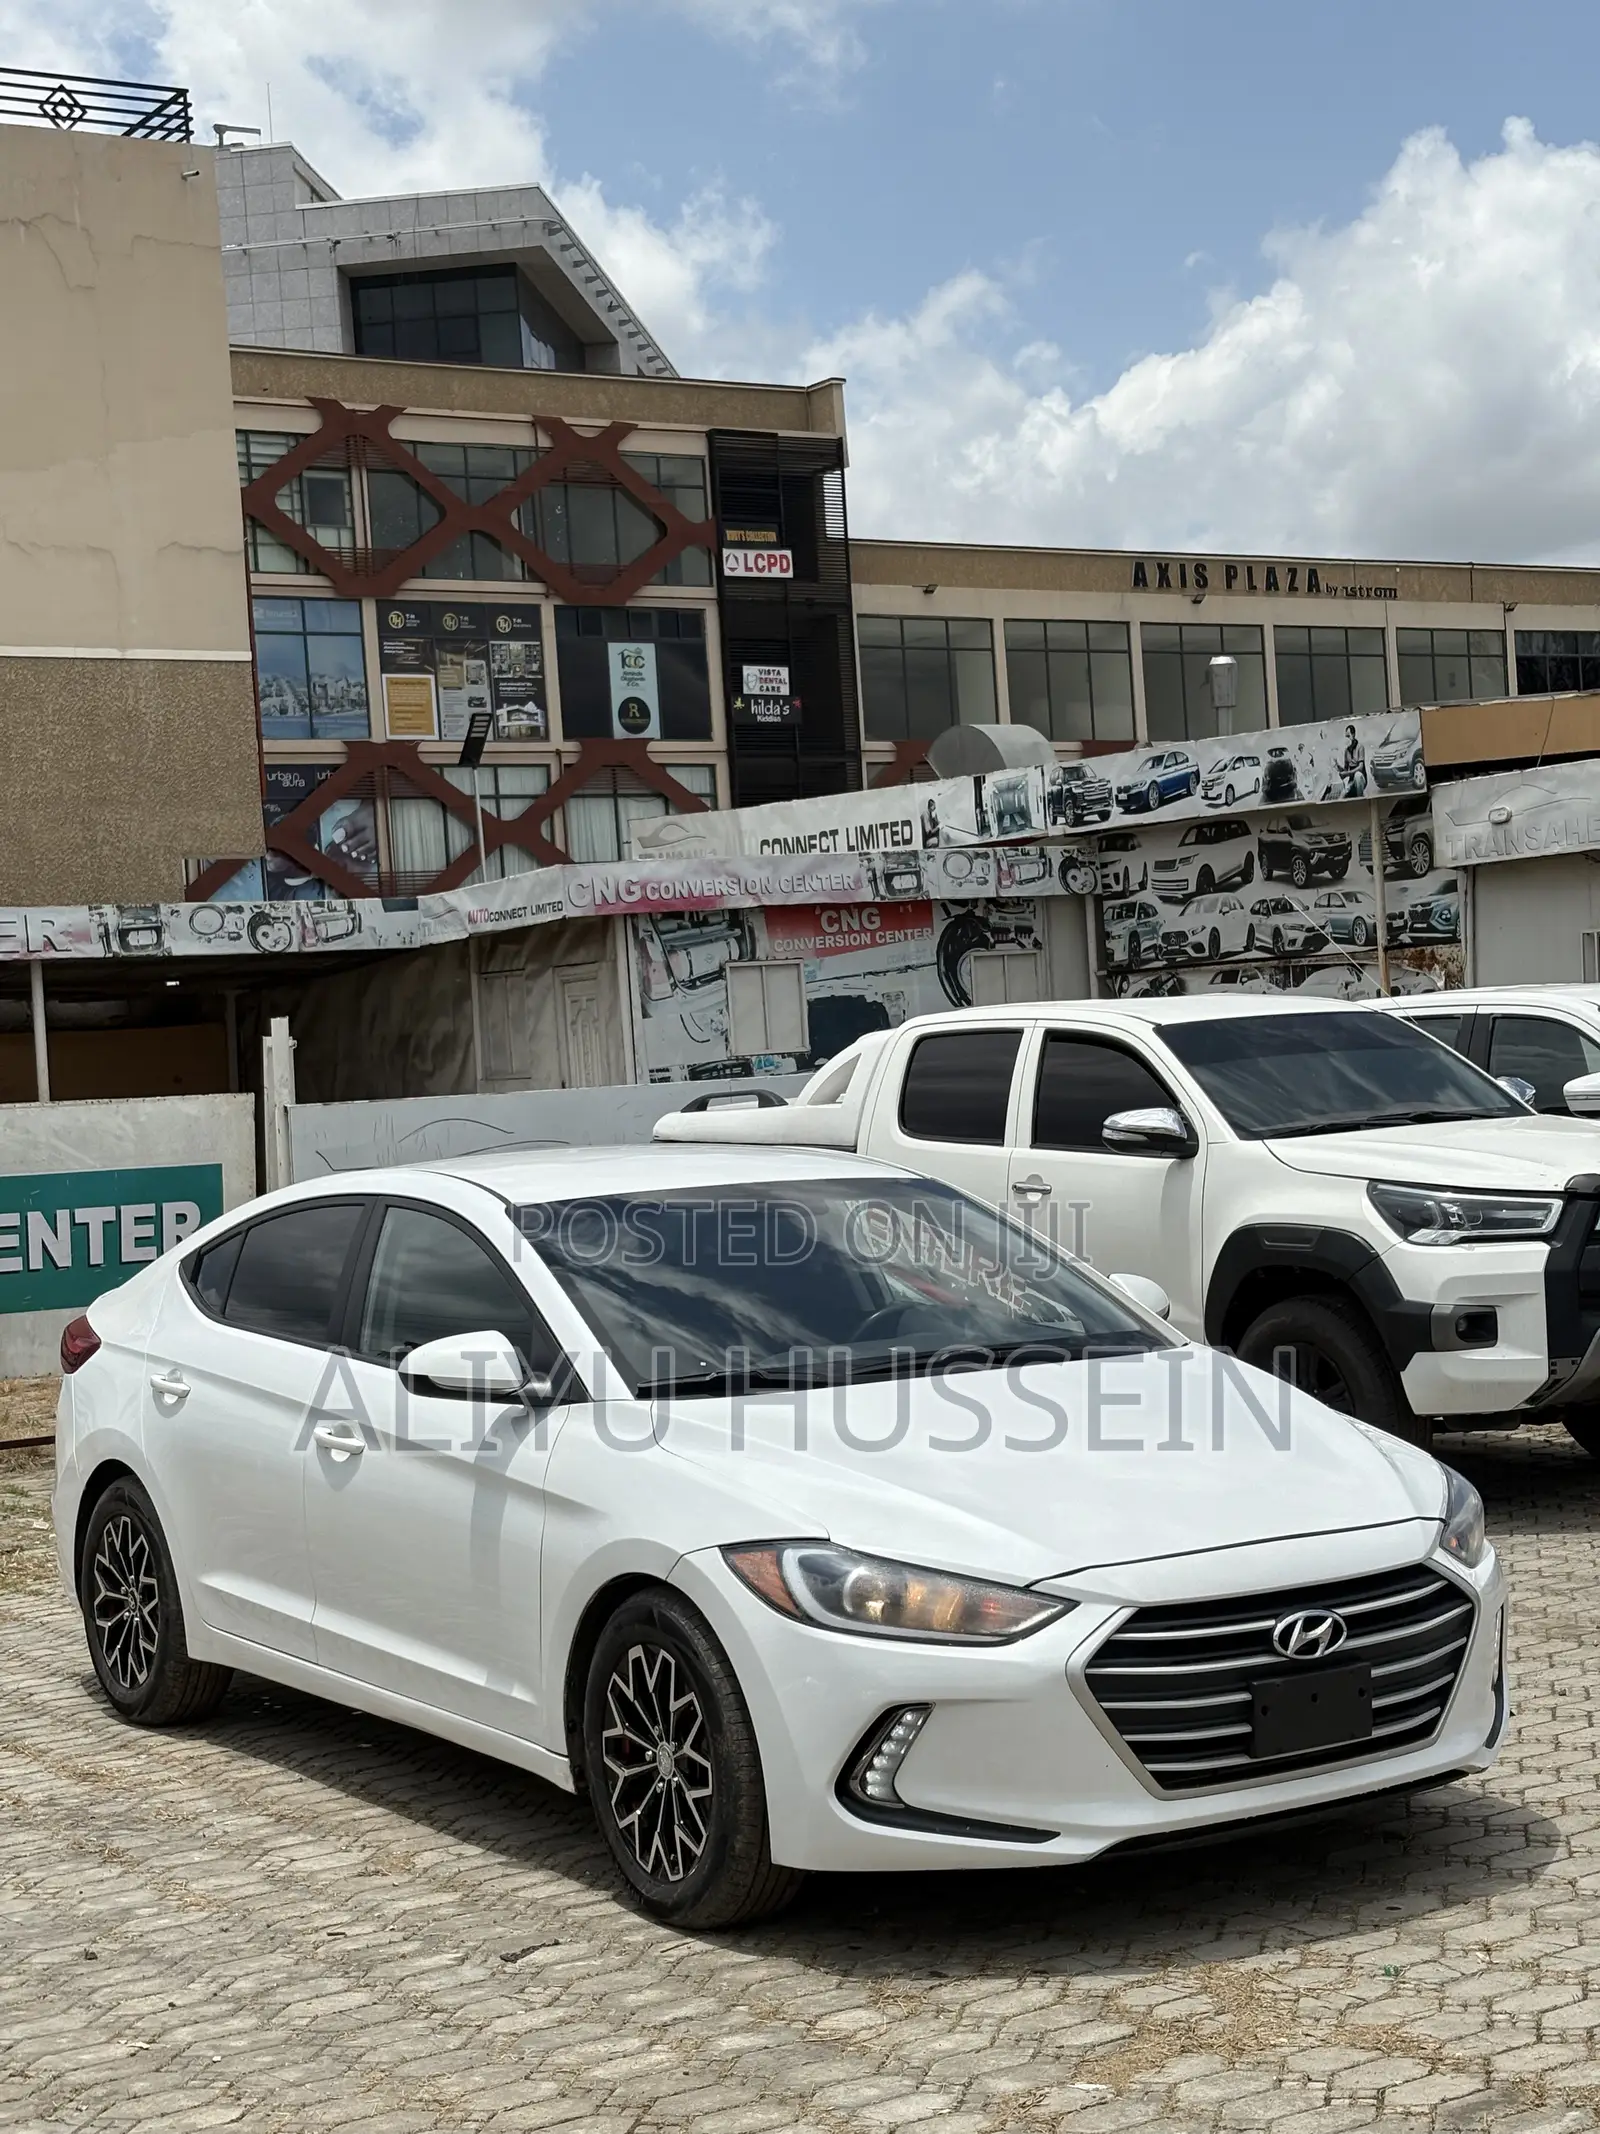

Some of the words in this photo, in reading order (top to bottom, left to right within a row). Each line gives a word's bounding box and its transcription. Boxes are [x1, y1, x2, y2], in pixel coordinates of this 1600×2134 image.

[743, 553, 790, 573] LCPD
[1132, 562, 1208, 589] AXIS
[1224, 564, 1321, 593] PLAZA
[1325, 582, 1338, 597] by
[758, 668, 781, 676] VISTA
[759, 677, 787, 685] DENTAL
[759, 685, 781, 693] CARE
[629, 703, 640, 717] R
[751, 699, 790, 715] hilda's
[266, 771, 300, 781] urban
[282, 779, 306, 788] aura
[846, 819, 913, 851] LIMITED
[567, 873, 642, 908] CNG
[645, 876, 772, 901] CONVERSION
[778, 873, 855, 895] CENTER
[530, 900, 563, 916] LIMITED
[820, 907, 881, 933] CNG
[774, 932, 871, 953] CONVERSION
[876, 927, 932, 944] CENTER
